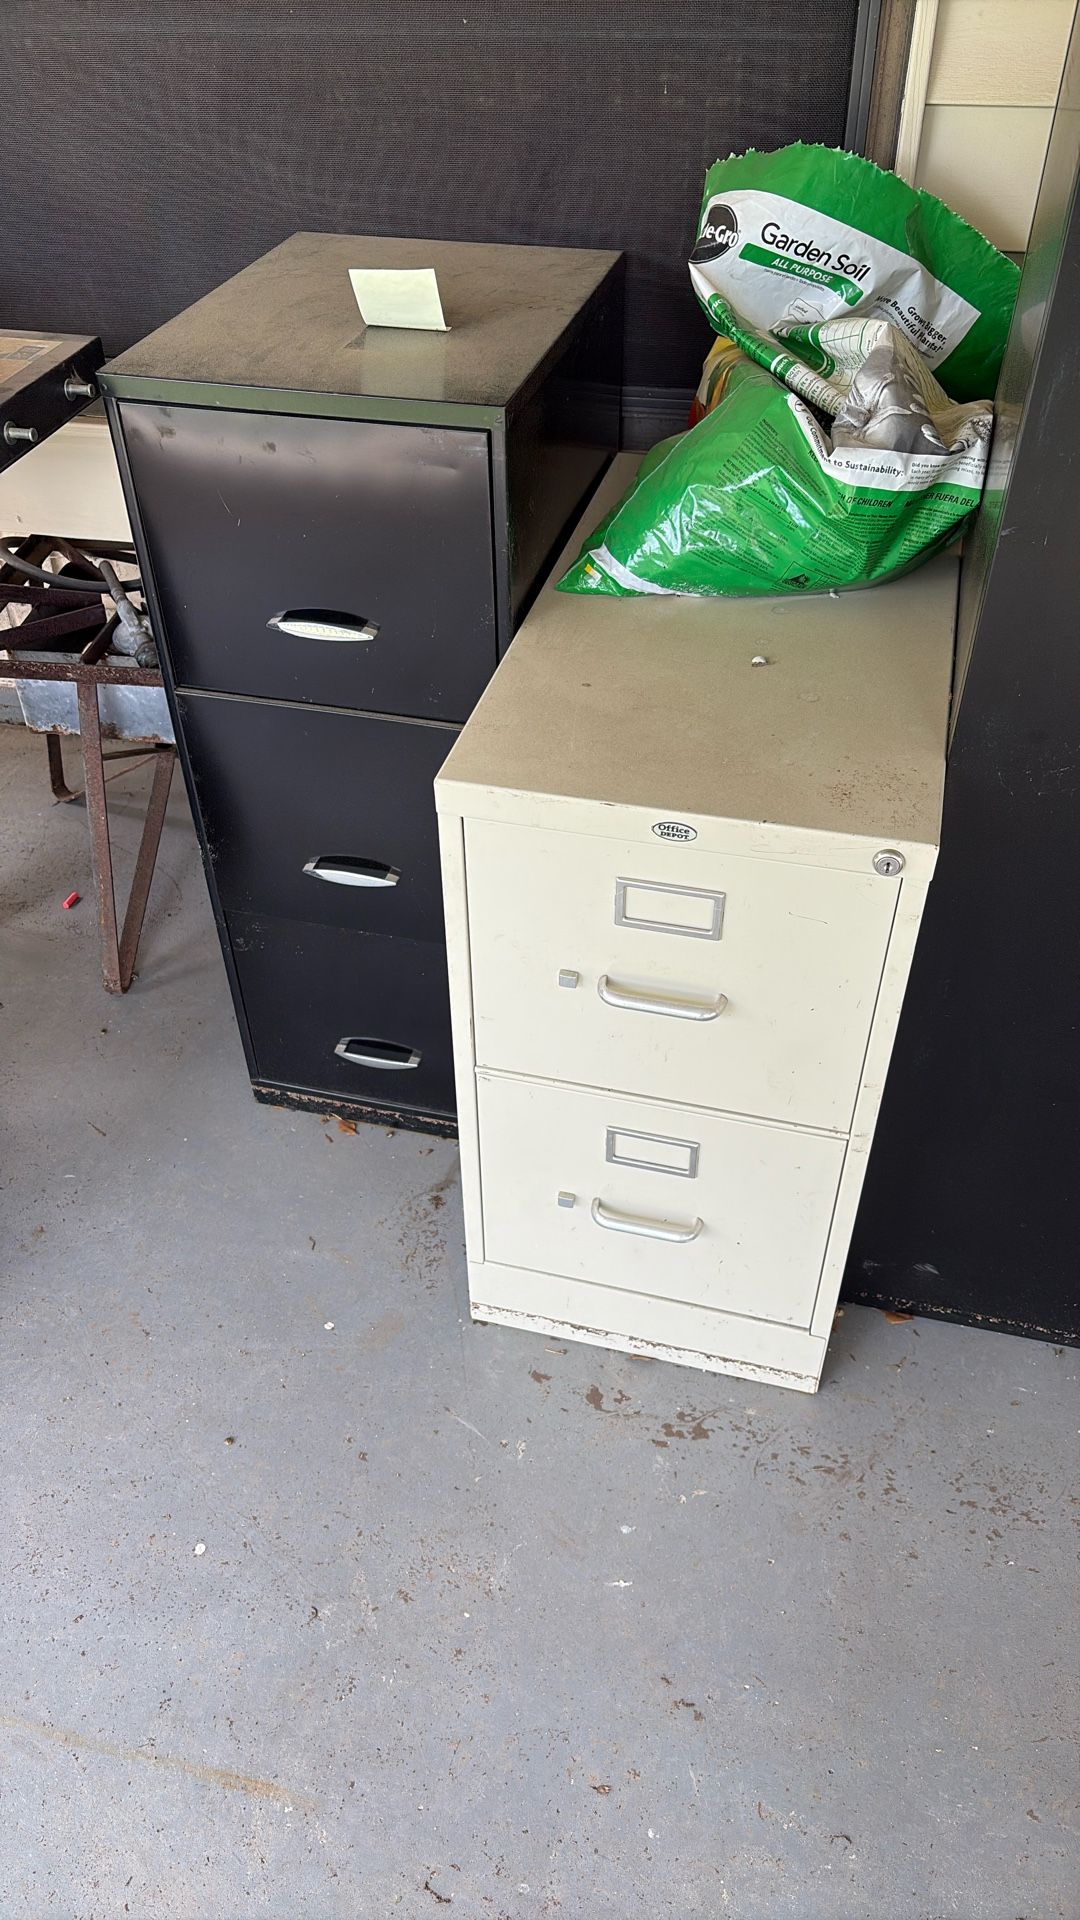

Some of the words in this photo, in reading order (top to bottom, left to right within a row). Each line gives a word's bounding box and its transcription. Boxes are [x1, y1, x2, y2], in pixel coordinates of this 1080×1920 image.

[761, 222, 832, 267] Garden
[831, 254, 871, 282] Soil
[771, 257, 789, 269] ALL
[789, 263, 833, 283] PURPOSE
[890, 300, 921, 336] Beautiful
[834, 459, 843, 467] to
[844, 460, 904, 477] Sustainability:
[856, 497, 893, 508] CHILDREN
[934, 493, 959, 504] FUERA
[960, 498, 975, 507] DEL
[658, 824, 690, 834] Office
[660, 831, 689, 840] DEPOT
